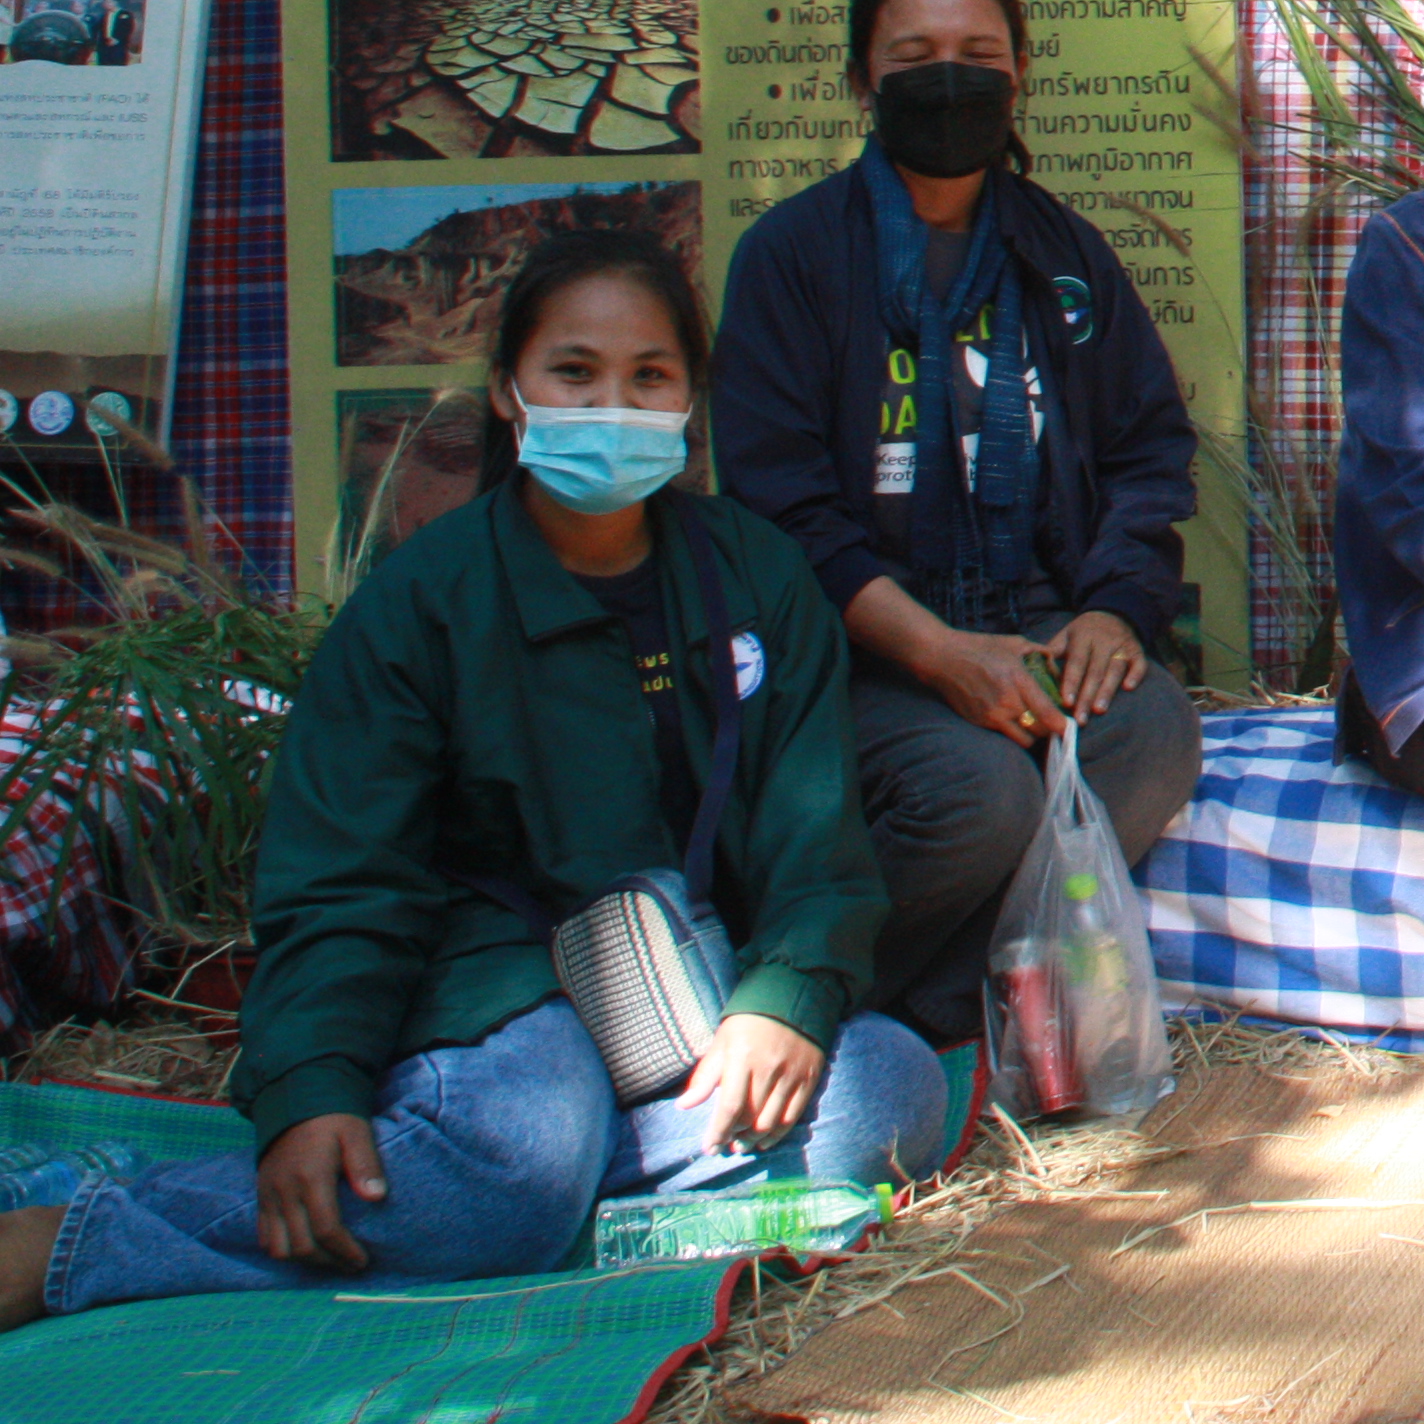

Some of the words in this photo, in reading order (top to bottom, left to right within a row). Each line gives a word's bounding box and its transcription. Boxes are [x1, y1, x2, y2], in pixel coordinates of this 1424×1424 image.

[1034, 147, 1193, 181] ภาพภูมิอากาศ
